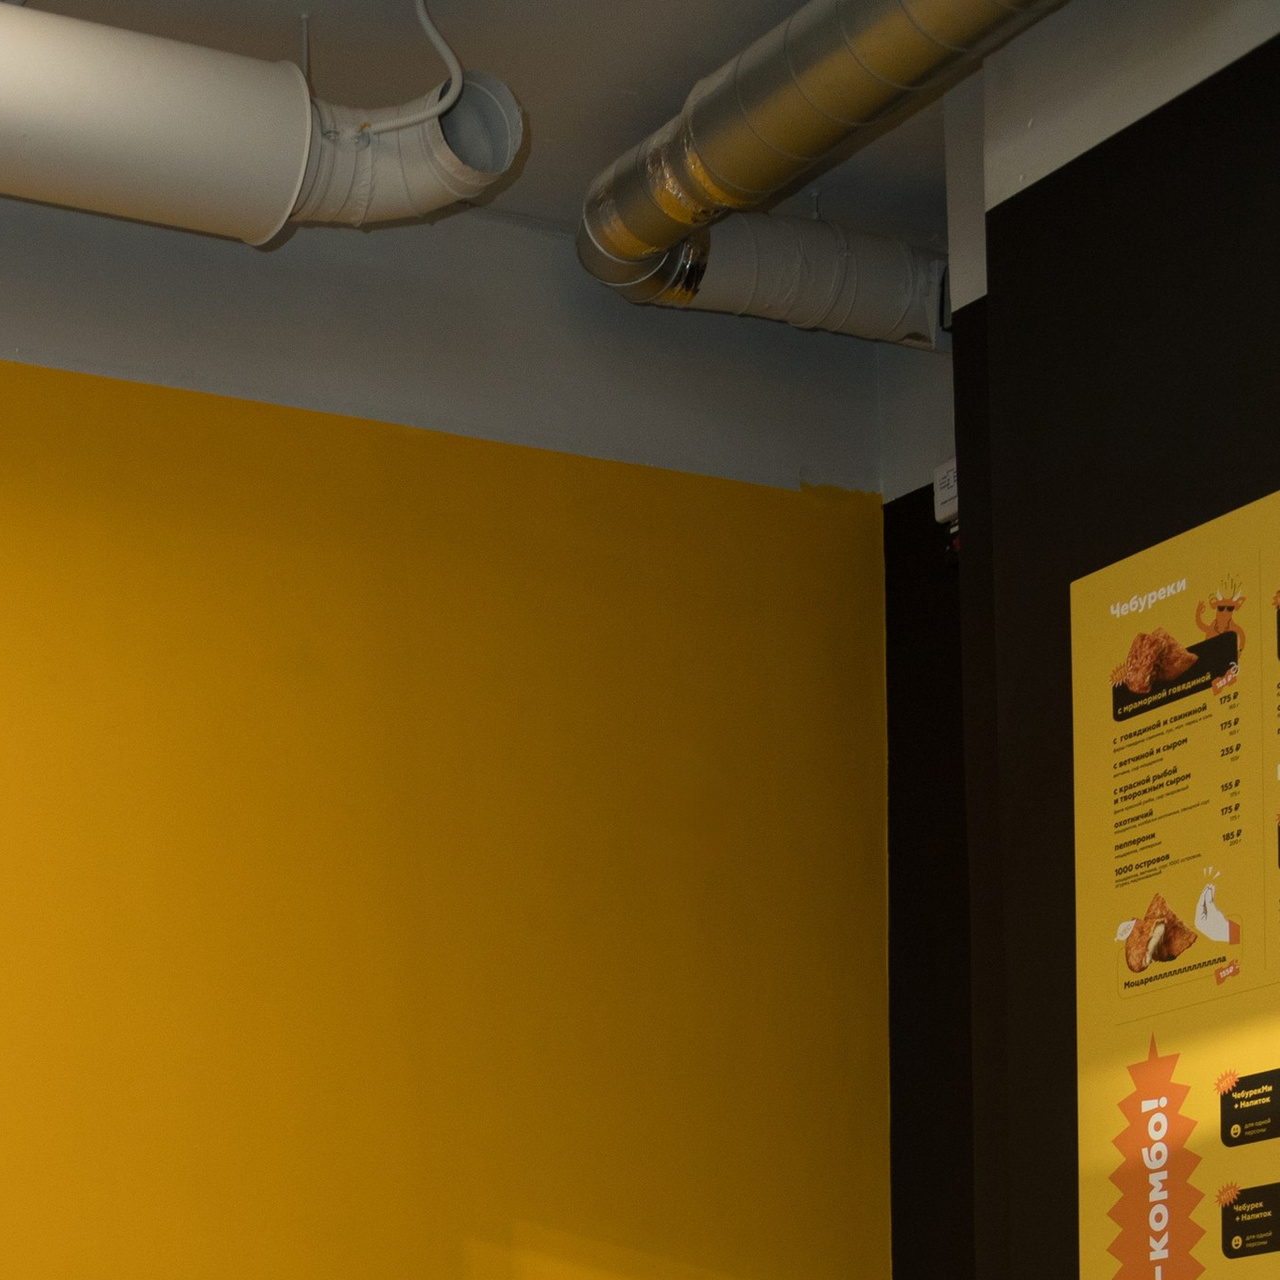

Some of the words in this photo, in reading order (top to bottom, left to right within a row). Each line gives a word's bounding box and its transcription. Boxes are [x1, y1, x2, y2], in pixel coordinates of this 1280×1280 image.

[1110, 578, 1187, 618] Чебуреки
[1123, 688, 1167, 713] мраморной
[1168, 671, 1211, 695] говядиной
[1120, 719, 1161, 742] говядиной
[1169, 702, 1208, 724] свининой
[1119, 747, 1154, 768] ветчиной
[1162, 737, 1188, 752] сыром
[1119, 773, 1151, 793] красной
[1152, 765, 1178, 783] рыбой
[1120, 782, 1165, 804] творожным
[1165, 772, 1191, 787] сыром
[1114, 808, 1154, 829] охотничий
[1114, 832, 1156, 851] пепперони
[1114, 864, 1134, 877] 1000
[1134, 853, 1170, 871] островов
[1232, 1085, 1273, 1099] ЧебурекМи
[1240, 1096, 1271, 1109] Напиток
[1233, 1201, 1263, 1212] Чебурек
[1241, 1210, 1272, 1221] Напиток
